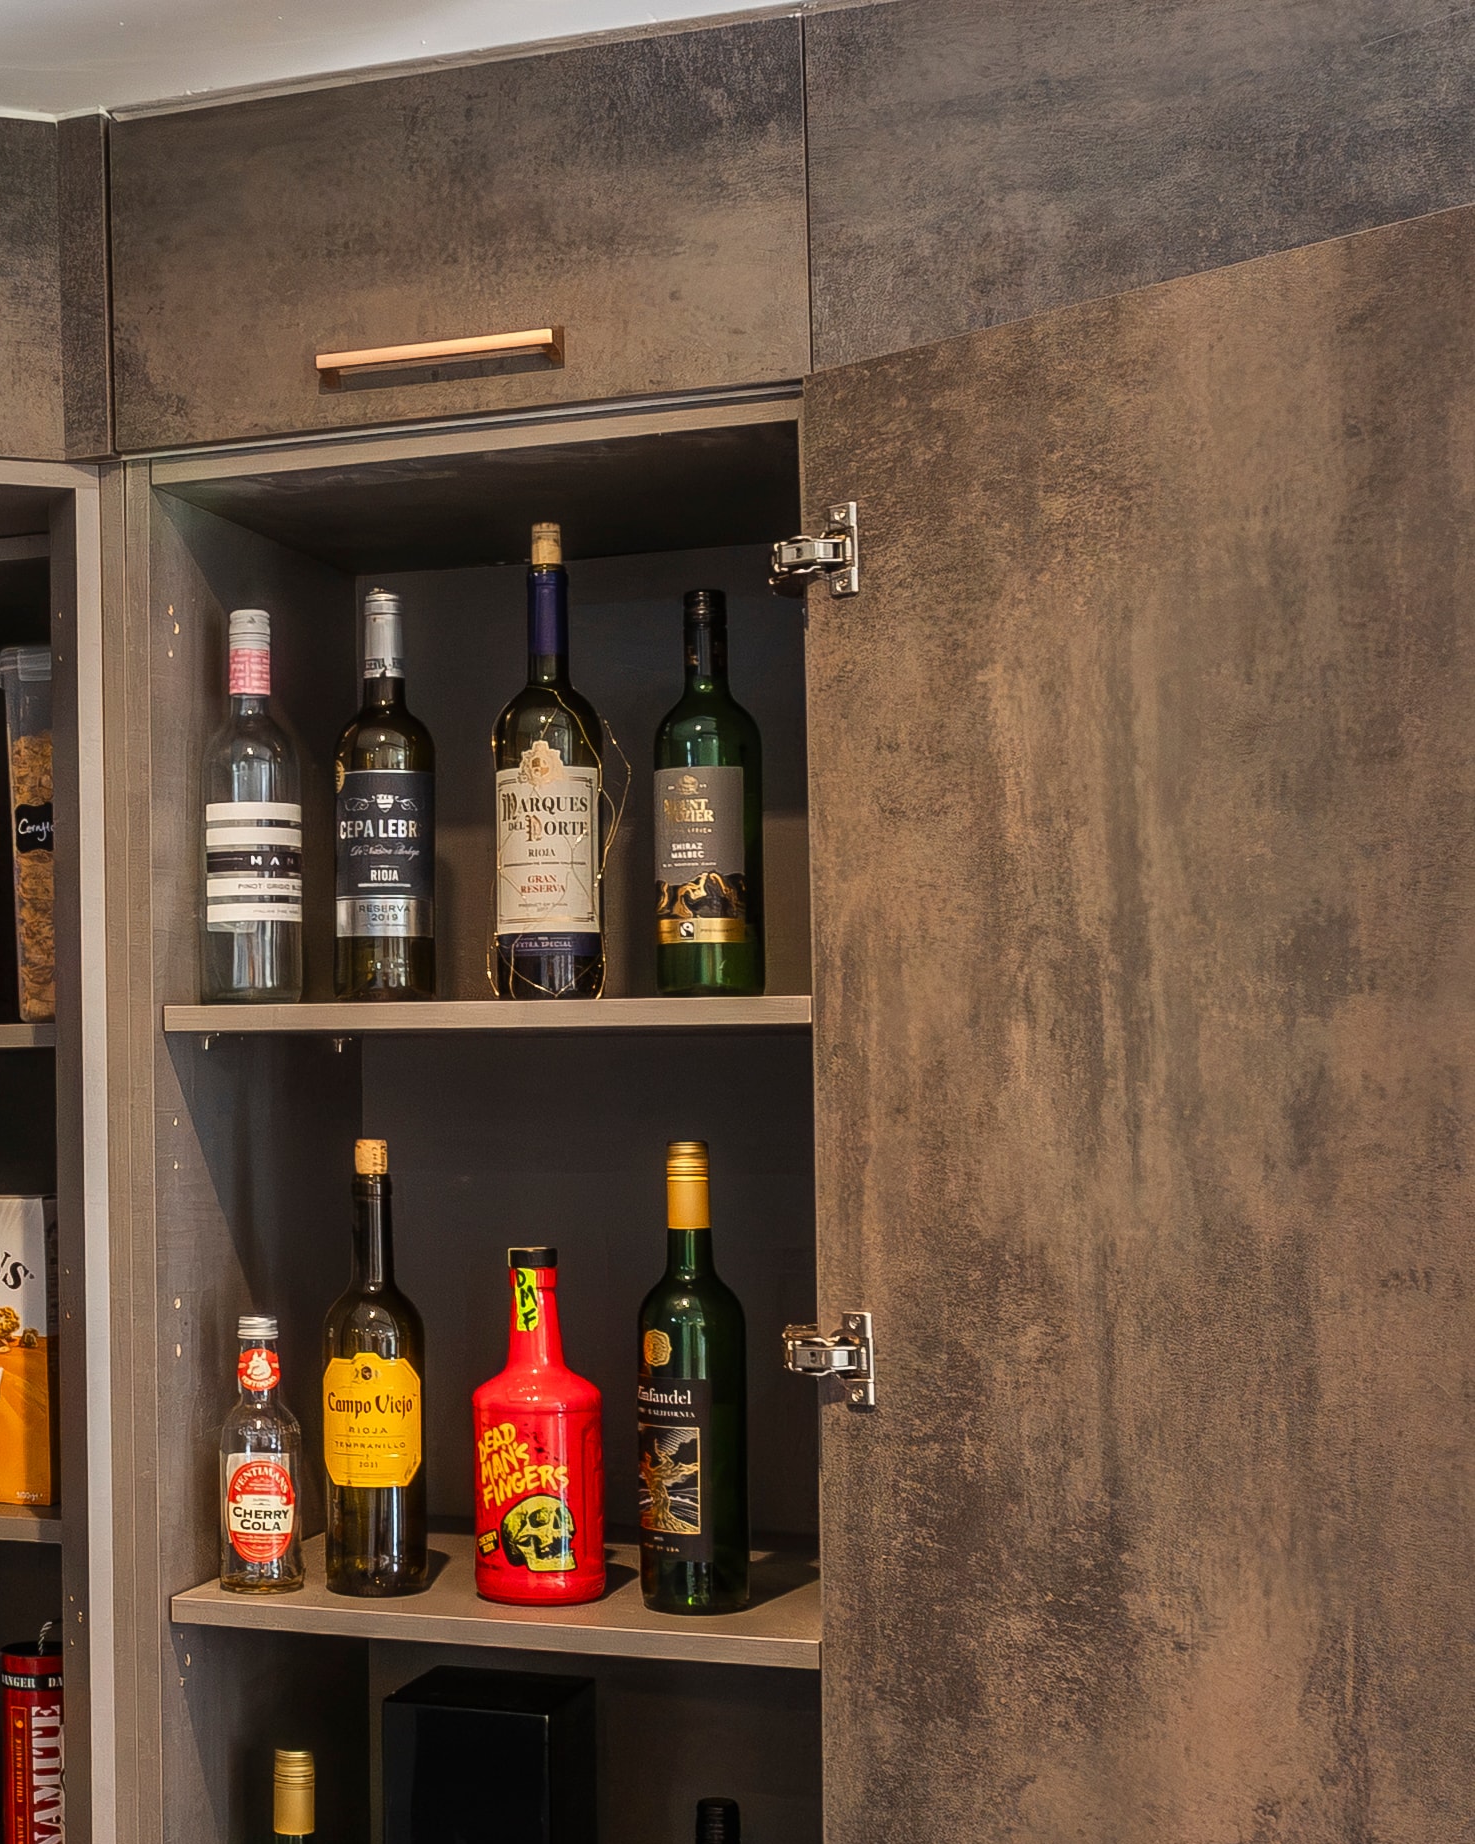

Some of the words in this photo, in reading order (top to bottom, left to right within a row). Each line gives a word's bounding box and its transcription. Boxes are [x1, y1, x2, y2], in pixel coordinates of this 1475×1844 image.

[502, 792, 588, 822] MARQUES
[340, 820, 374, 839] CEPA
[378, 819, 419, 838] LEBR
[508, 822, 525, 831] DEL
[671, 842, 703, 851] SHIRAZ
[528, 849, 556, 857] RIOJA
[671, 851, 705, 859] MALBEC
[370, 869, 399, 881] RIOJA
[527, 875, 557, 883] GRAN
[520, 885, 566, 893] RESERVA
[359, 904, 411, 913] RESERVA
[328, 1392, 372, 1420] Campo
[375, 1394, 413, 1420] Viejo
[349, 1426, 388, 1434] RIOJA
[335, 1440, 406, 1448] TEMPRANILLO
[478, 1422, 516, 1463] DEAD
[481, 1441, 530, 1485] MAN'S
[234, 1466, 288, 1493] FENTIMANS
[483, 1464, 569, 1510] FINGERS
